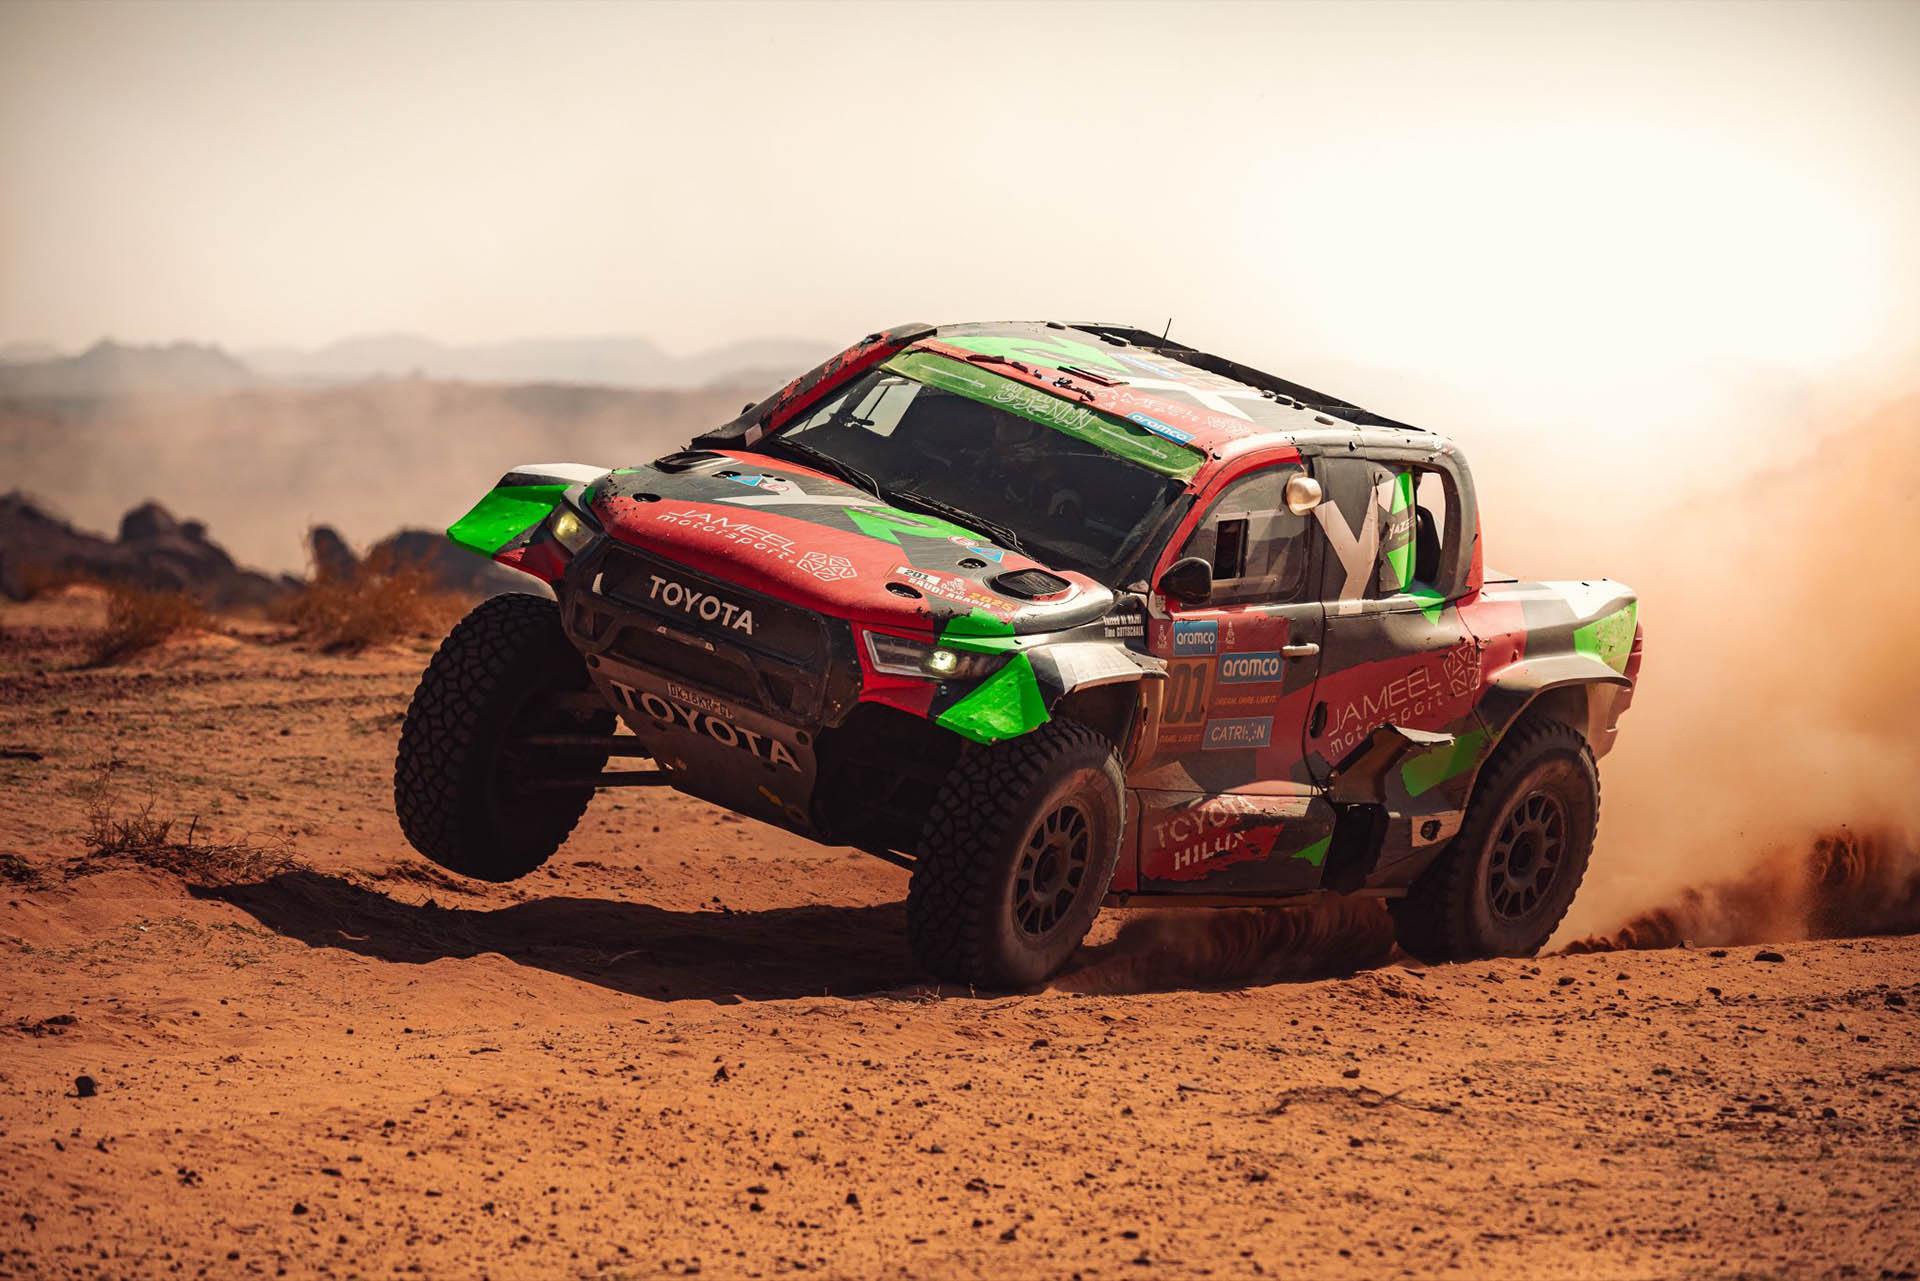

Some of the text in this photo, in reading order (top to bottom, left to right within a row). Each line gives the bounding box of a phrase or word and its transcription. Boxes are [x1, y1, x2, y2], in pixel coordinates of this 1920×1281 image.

[1131, 413, 1189, 441] aramco
[668, 509, 796, 554] JAMEEL
[907, 577, 944, 596] SAUDI
[649, 574, 754, 636] TOYOTA
[945, 592, 992, 610] ARABIA
[968, 591, 1014, 612] 2025
[1176, 631, 1215, 647] aramco
[1222, 657, 1280, 678] aramco
[1328, 667, 1441, 737] JAMEEL
[610, 680, 802, 772] TOYOTA
